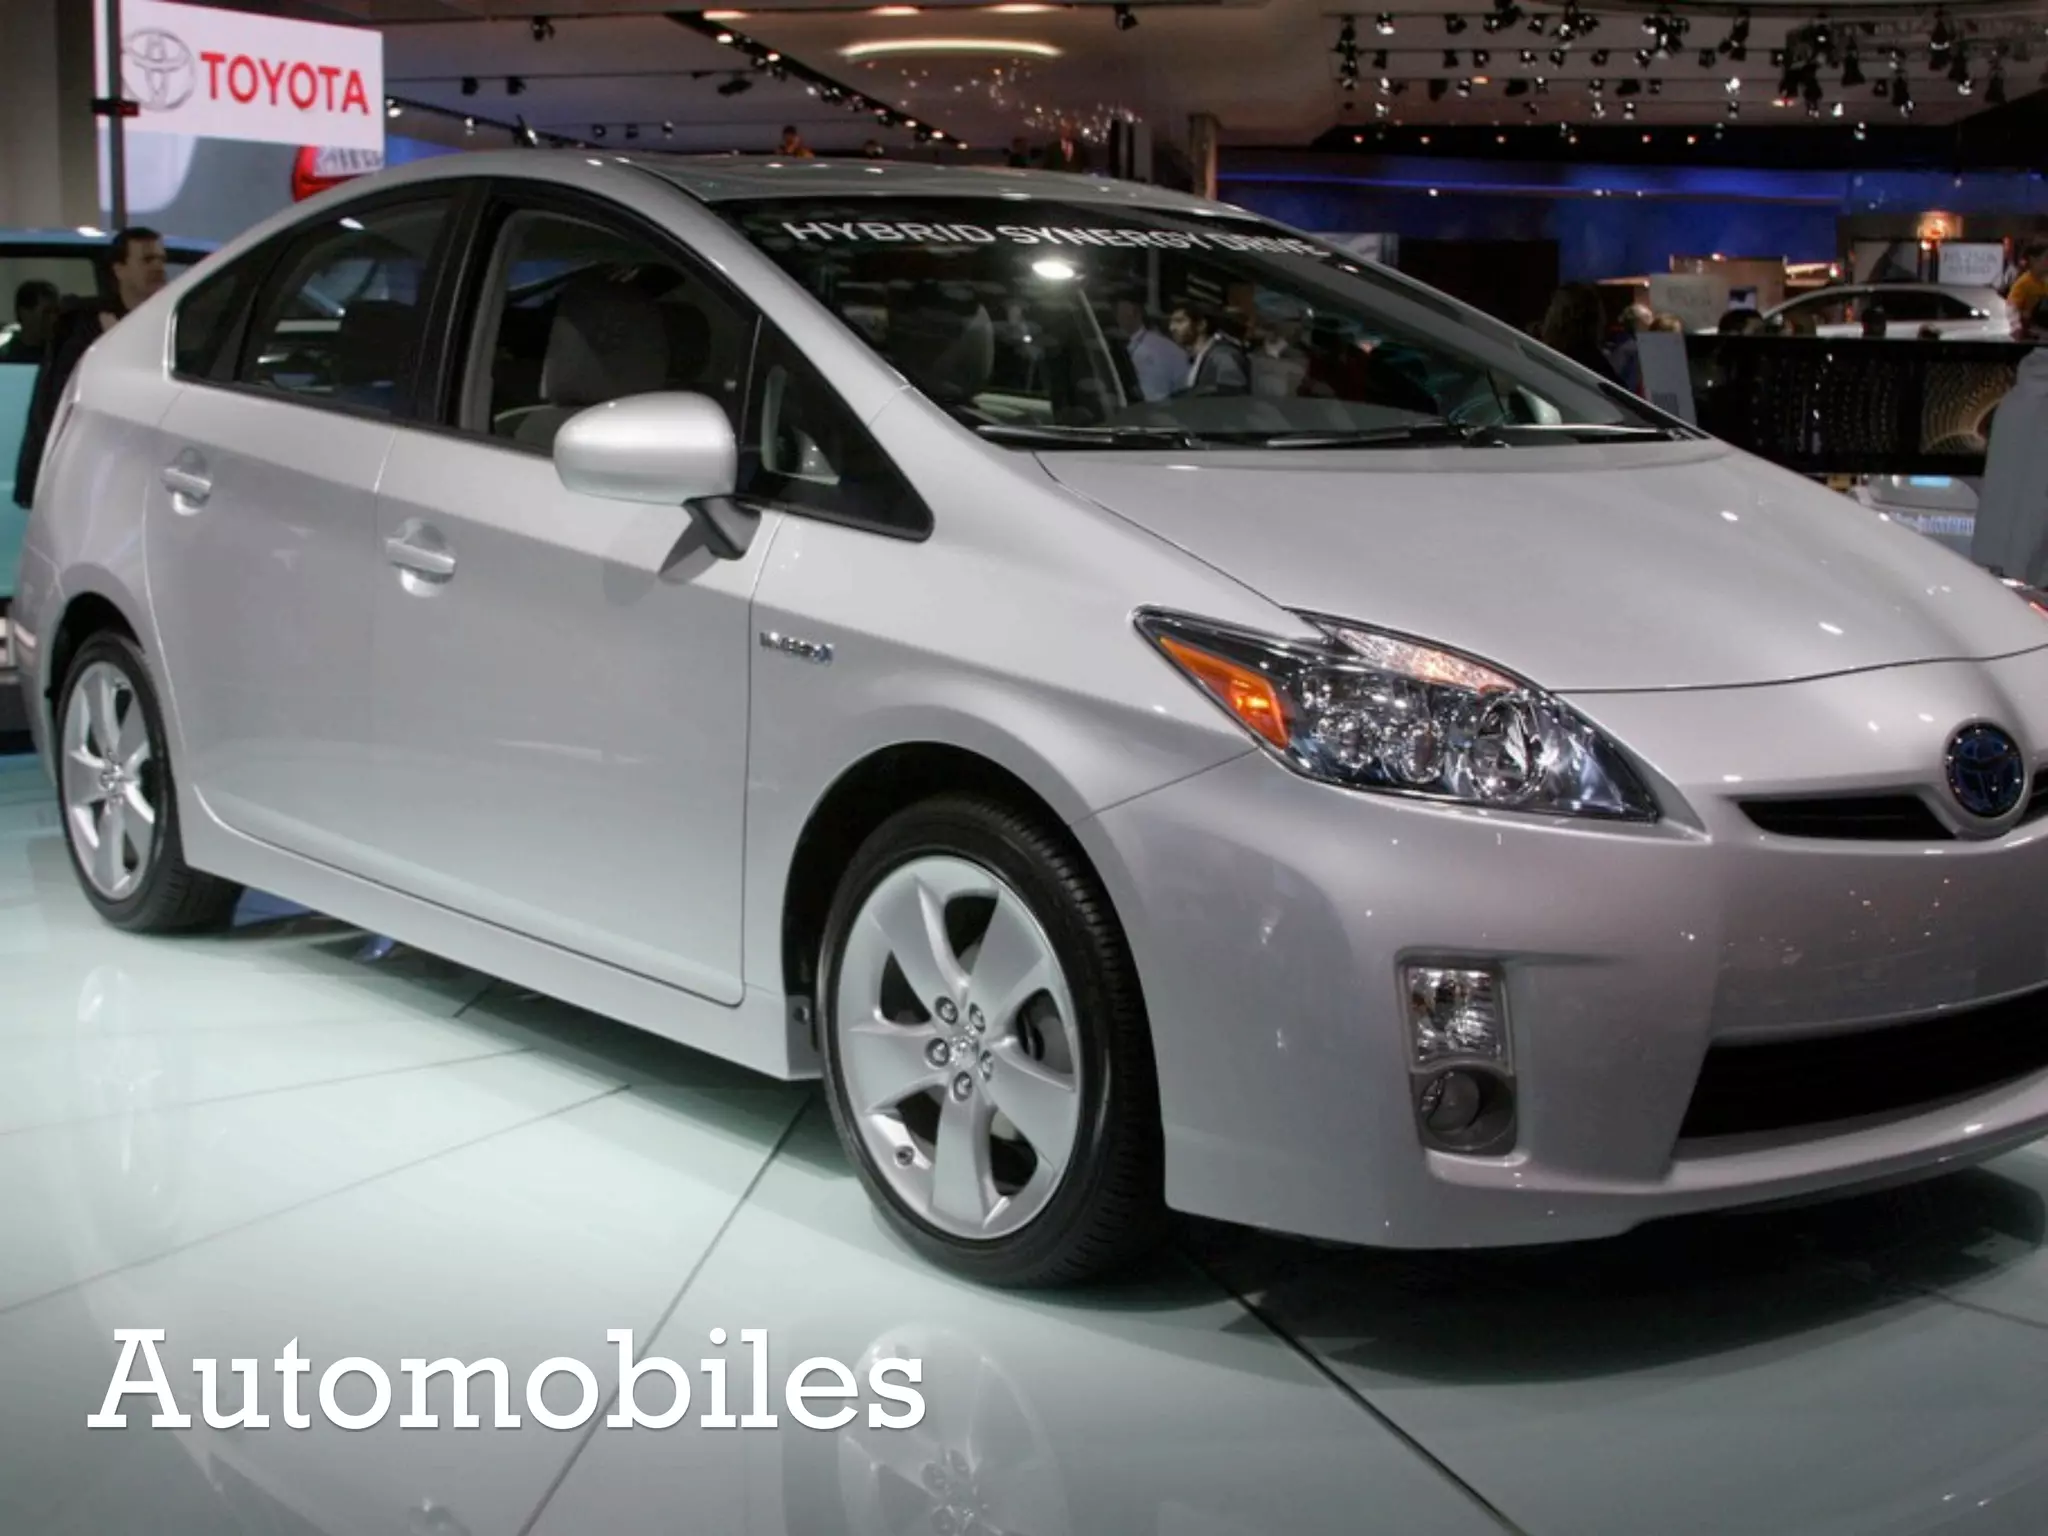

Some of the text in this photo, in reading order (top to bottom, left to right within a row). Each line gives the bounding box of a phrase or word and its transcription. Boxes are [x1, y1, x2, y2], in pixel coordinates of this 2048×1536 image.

[200, 51, 371, 116] TOYOTA
[782, 222, 997, 242] HYBRID
[996, 225, 1214, 250] SYNERGY
